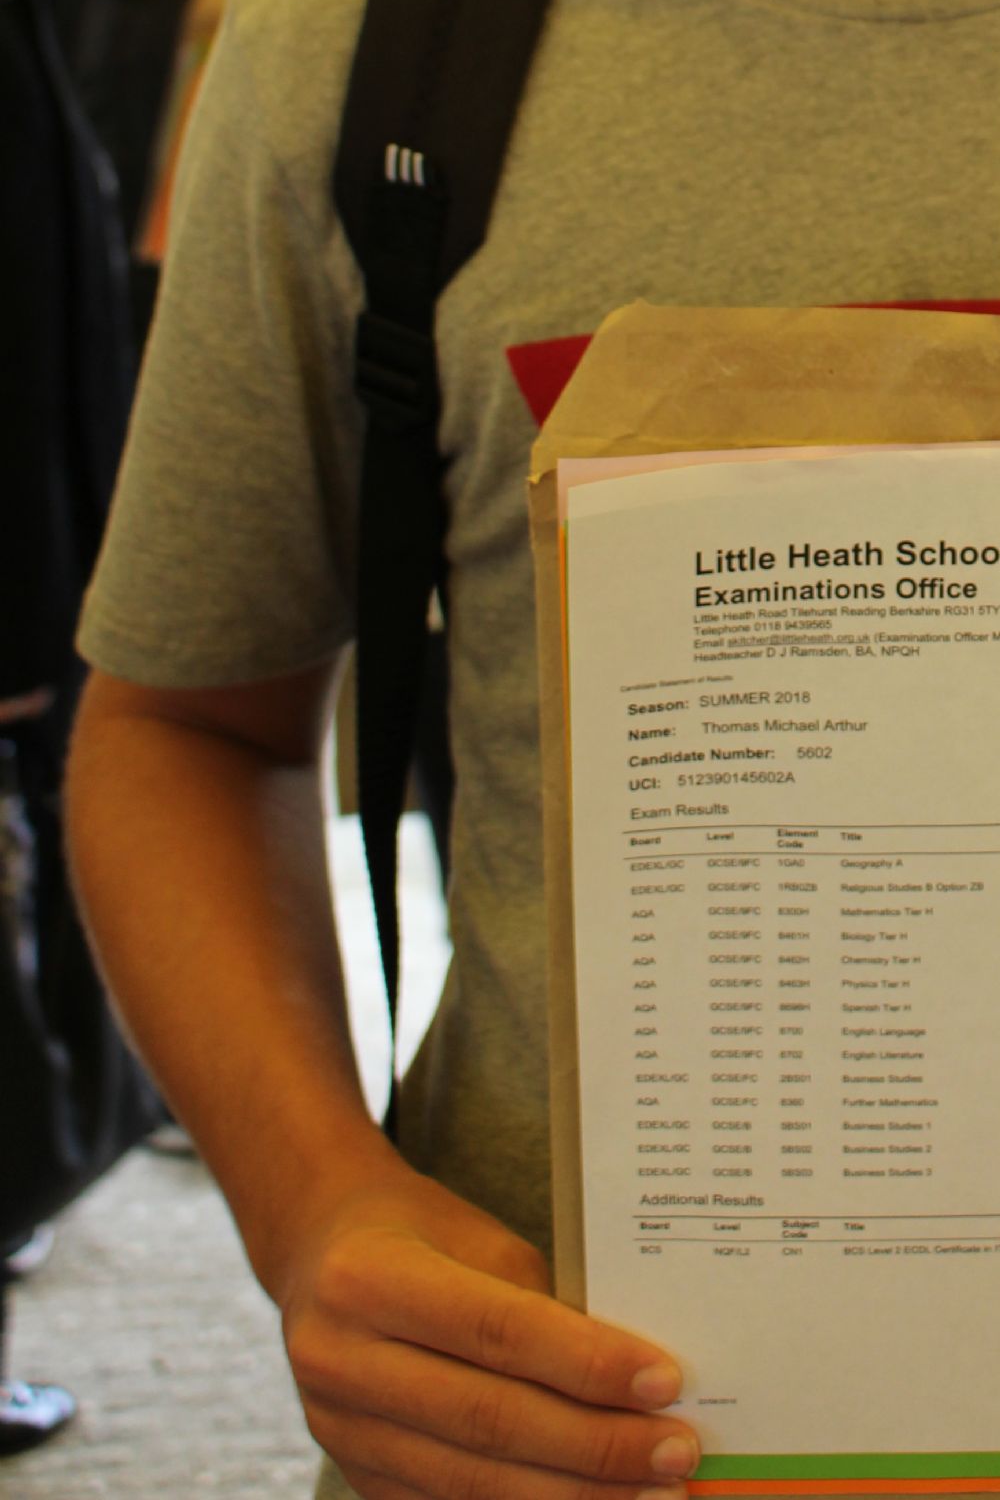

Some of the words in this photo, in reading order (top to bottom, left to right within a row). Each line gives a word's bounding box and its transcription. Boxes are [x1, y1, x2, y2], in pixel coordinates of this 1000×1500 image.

[696, 547, 775, 575] Little
[789, 541, 882, 568] Heath
[695, 580, 885, 606] Examinations
[896, 577, 977, 599] Office
[694, 614, 719, 624] Little
[722, 611, 755, 620] Heath
[758, 609, 788, 619] Road
[790, 608, 837, 617] Tilehurst
[840, 606, 886, 618] Reading
[889, 606, 941, 616] Berkshire
[944, 605, 974, 616] RG31
[979, 604, 1000, 616] 5TY
[693, 623, 752, 638] Telephone
[754, 621, 781, 632] 0118
[784, 620, 832, 630] 9439565
[694, 638, 724, 649] Email
[874, 632, 951, 643] (Examinations
[954, 632, 989, 642] Officer
[694, 647, 763, 662] Headteacher
[766, 647, 776, 657] D
[779, 647, 787, 658] J
[790, 646, 851, 657] Ramsden,
[881, 646, 920, 657] NPQH
[628, 701, 688, 716] Season:
[700, 692, 770, 707] SUMMER
[775, 691, 811, 704] 2018
[628, 728, 675, 741] Name:
[701, 722, 760, 734] Thomas
[764, 719, 819, 732] Michael
[823, 719, 868, 732] Arthur
[628, 751, 705, 767] Candidate
[710, 748, 774, 760] Number:
[797, 747, 832, 759] 5602
[629, 778, 660, 791] UCI:
[678, 771, 795, 787] 512390145602A
[630, 808, 671, 820] Exam
[675, 804, 729, 816] Results
[840, 832, 862, 841] Title
[639, 1194, 709, 1206] Additional
[712, 1194, 764, 1207] Results
